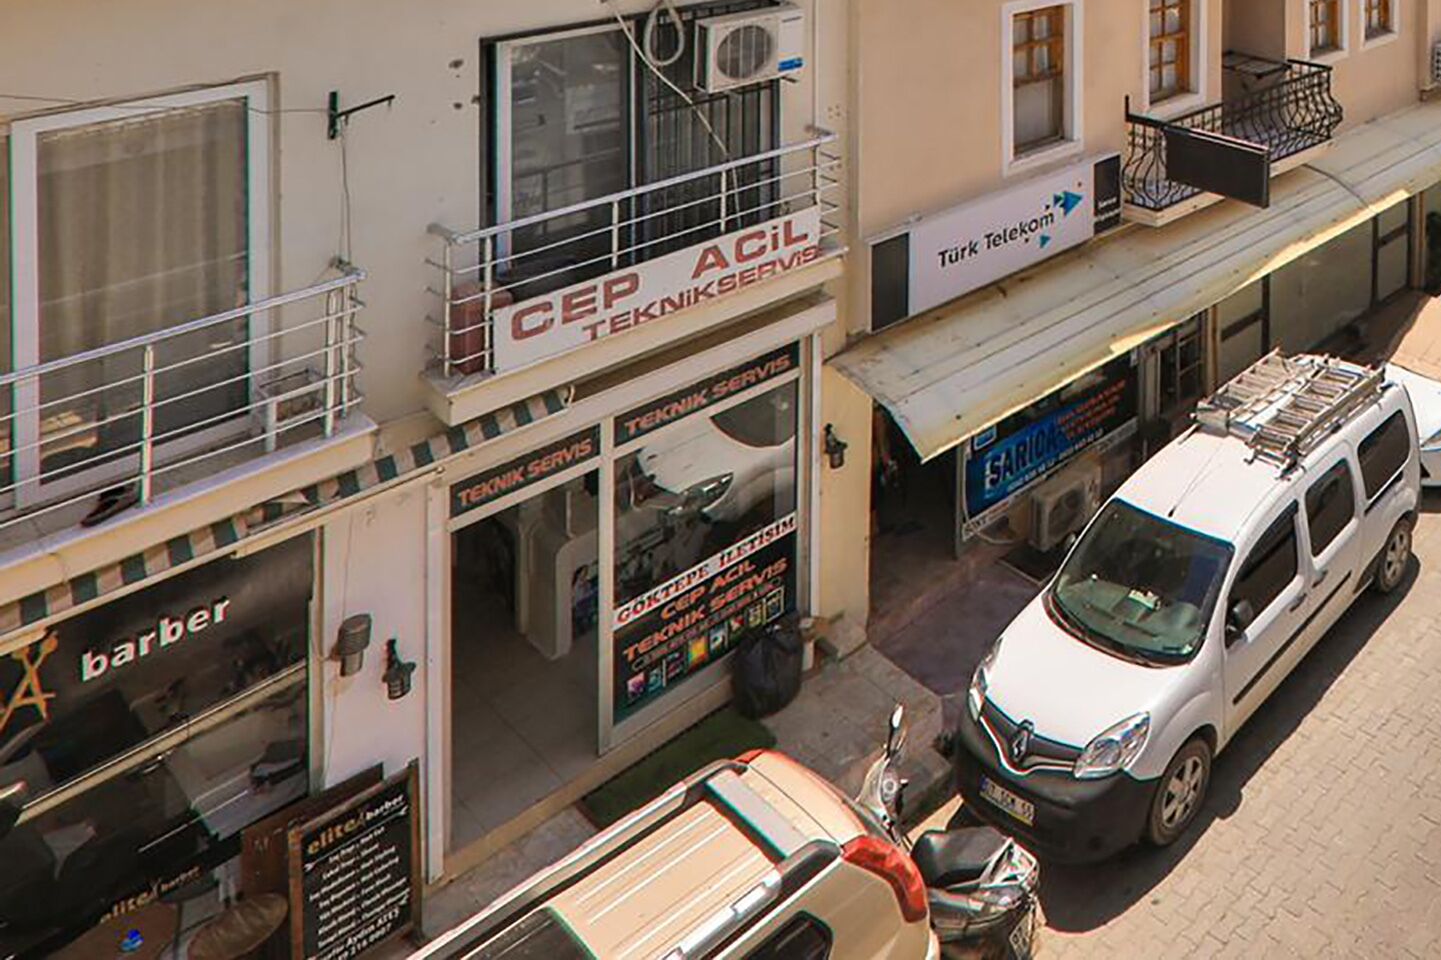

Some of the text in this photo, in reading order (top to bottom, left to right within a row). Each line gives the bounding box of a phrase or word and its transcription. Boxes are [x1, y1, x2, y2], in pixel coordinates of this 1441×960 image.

[938, 212, 1054, 267] Türk Telekom
[511, 272, 640, 341] CEP
[661, 585, 707, 620] CEP
[81, 596, 231, 681] barber
